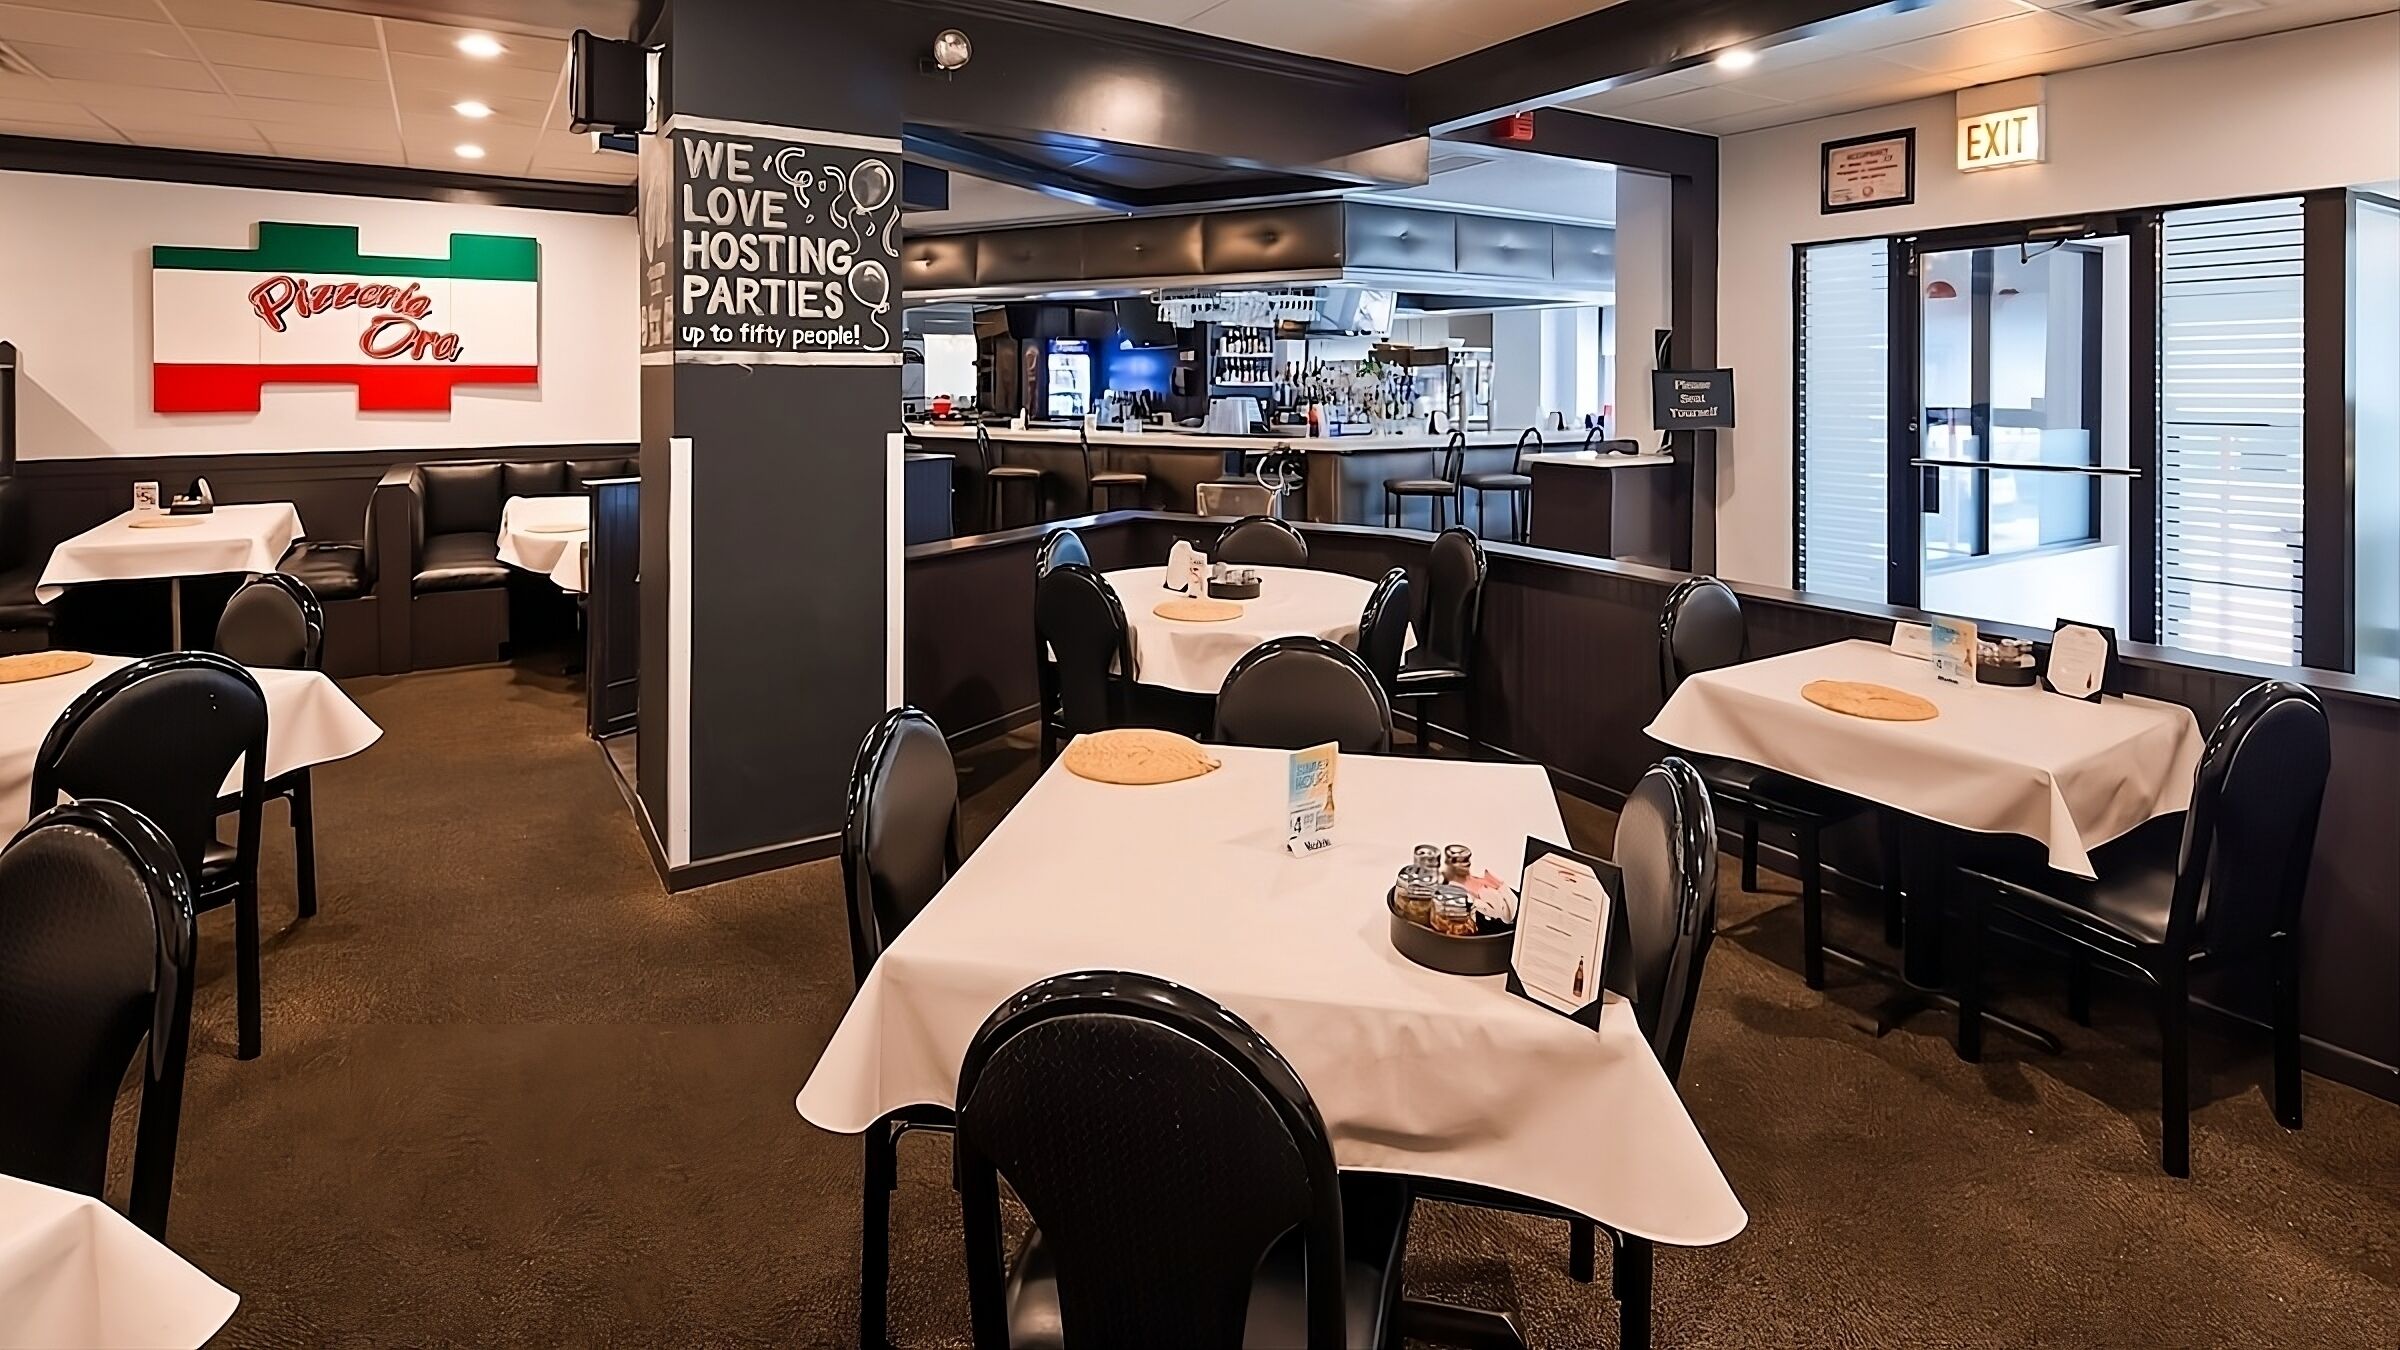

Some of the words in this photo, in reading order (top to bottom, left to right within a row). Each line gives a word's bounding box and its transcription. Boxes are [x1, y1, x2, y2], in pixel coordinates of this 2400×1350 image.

[683, 137, 754, 183] WE
[1967, 116, 2028, 161] EXIT
[683, 184, 788, 228] LOVE
[683, 230, 852, 275] HOSTING
[247, 274, 432, 332] Pizzeria
[682, 275, 844, 320] PARTIES
[359, 314, 464, 362] Ora
[682, 325, 705, 347] up
[710, 324, 733, 343] to
[740, 322, 787, 348] fifty
[793, 324, 860, 349] people!
[1675, 379, 1711, 390] Please
[1679, 393, 1706, 404] Seat
[1669, 406, 1719, 418] Yourself
